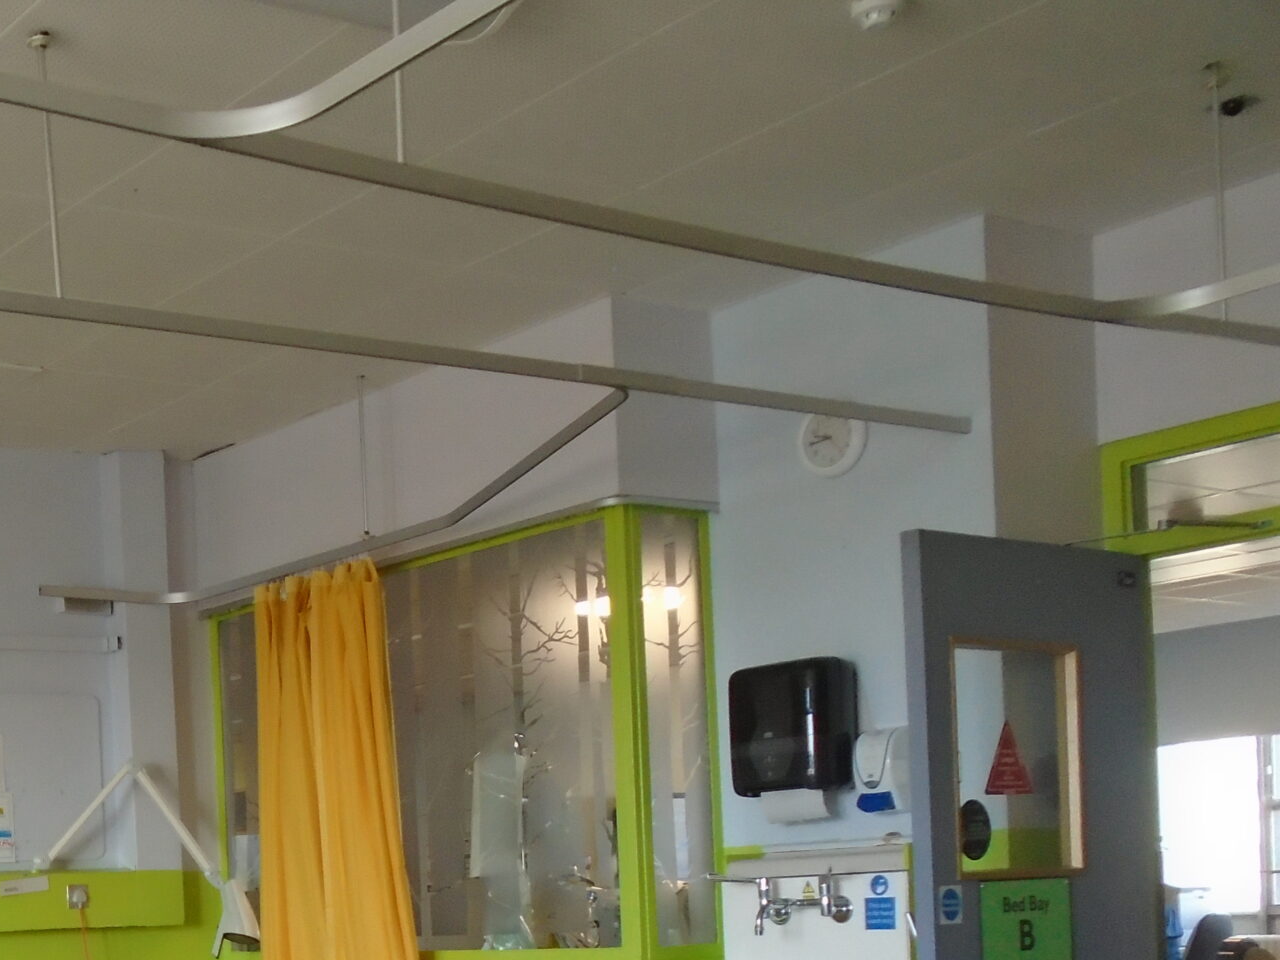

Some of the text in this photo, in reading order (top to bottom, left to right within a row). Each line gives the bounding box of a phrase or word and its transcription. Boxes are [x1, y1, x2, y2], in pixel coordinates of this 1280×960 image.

[1003, 895, 1050, 915] Bed Bay
[1019, 919, 1035, 951] B
